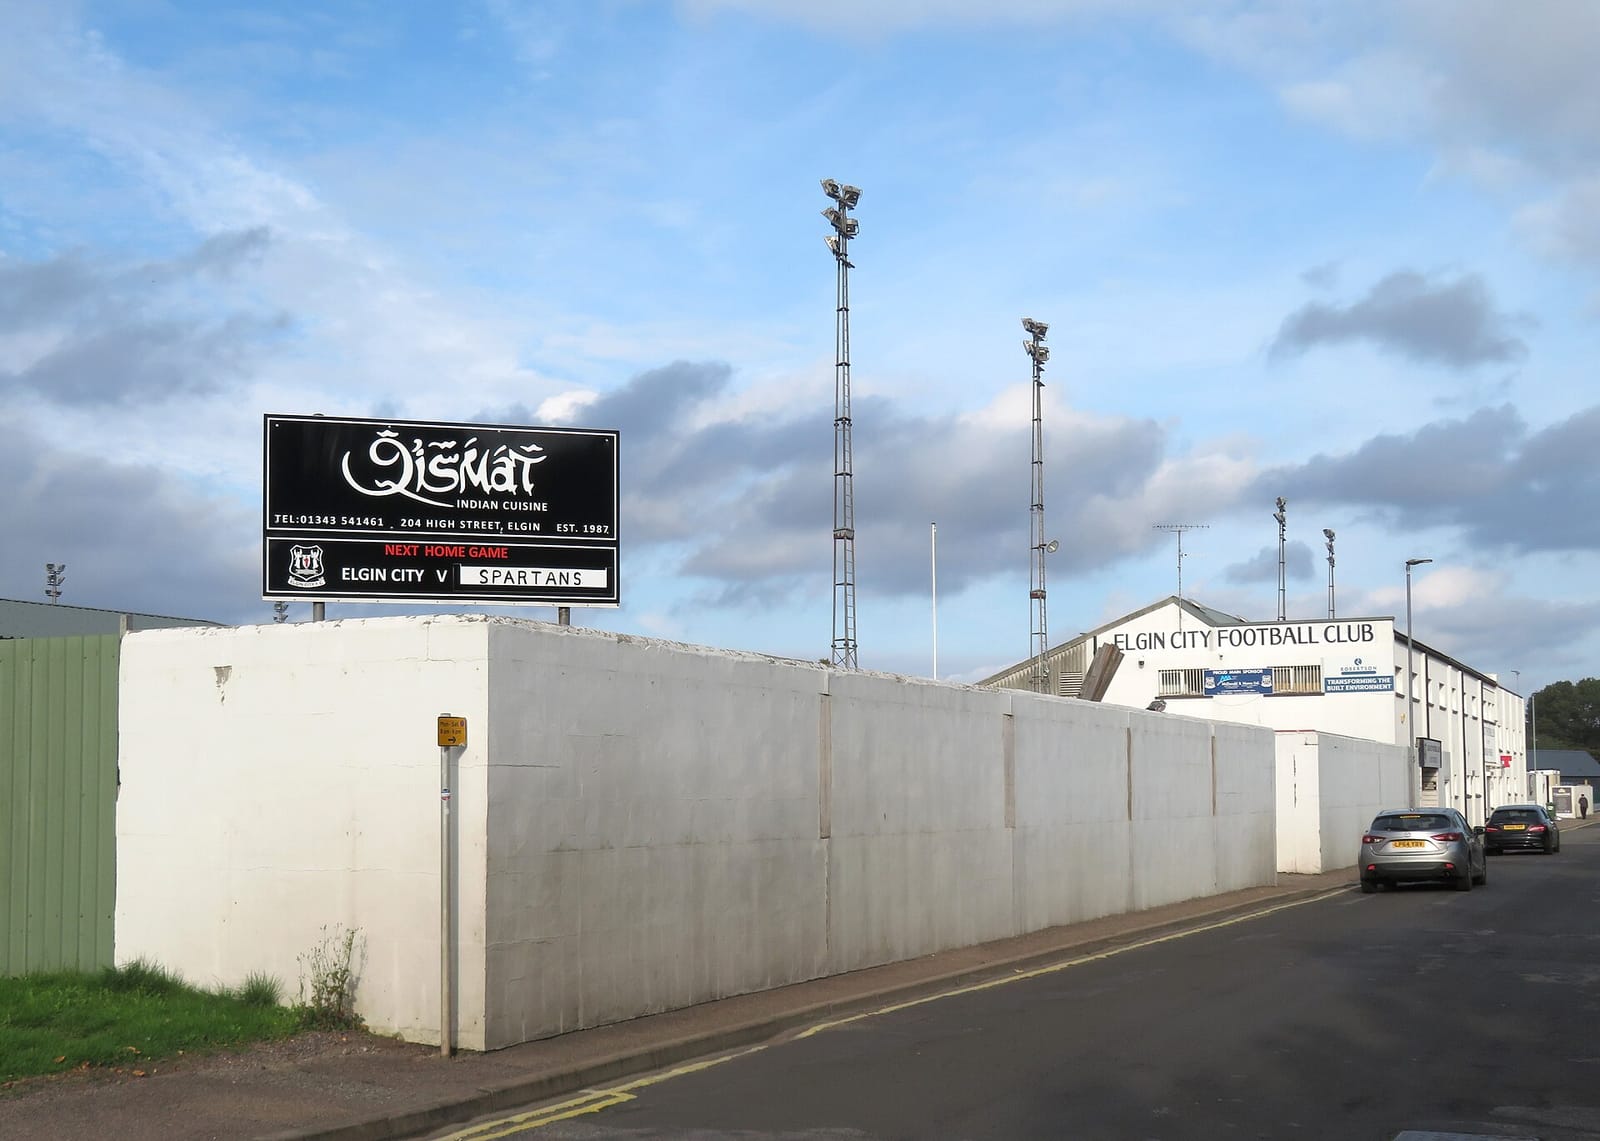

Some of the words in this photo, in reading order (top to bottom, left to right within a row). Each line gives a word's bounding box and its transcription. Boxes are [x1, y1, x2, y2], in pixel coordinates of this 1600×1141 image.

[456, 499, 499, 510] INDIAN
[502, 500, 549, 512] CUISINE
[274, 514, 337, 525] TEL:01343
[341, 516, 384, 527] 541461
[400, 518, 422, 528] 204
[426, 519, 455, 529] HIGH
[459, 520, 504, 531] STREET,
[507, 521, 541, 532] ELGIN
[556, 523, 578, 533] EST.
[583, 524, 609, 534] 1987
[384, 543, 420, 557] NEXT
[424, 545, 466, 558] HOME
[468, 546, 509, 559] GAME
[341, 566, 387, 582] ELGIN
[391, 568, 425, 583] CITY
[436, 569, 448, 583] V
[479, 568, 583, 586] SPARTANS
[1114, 632, 1166, 651] ELGIN
[1170, 630, 1212, 649] CITY
[1217, 626, 1320, 647] FOOTBALL
[1323, 623, 1375, 643] CLUB
[1345, 683, 1392, 691] ENVIRONMENT
